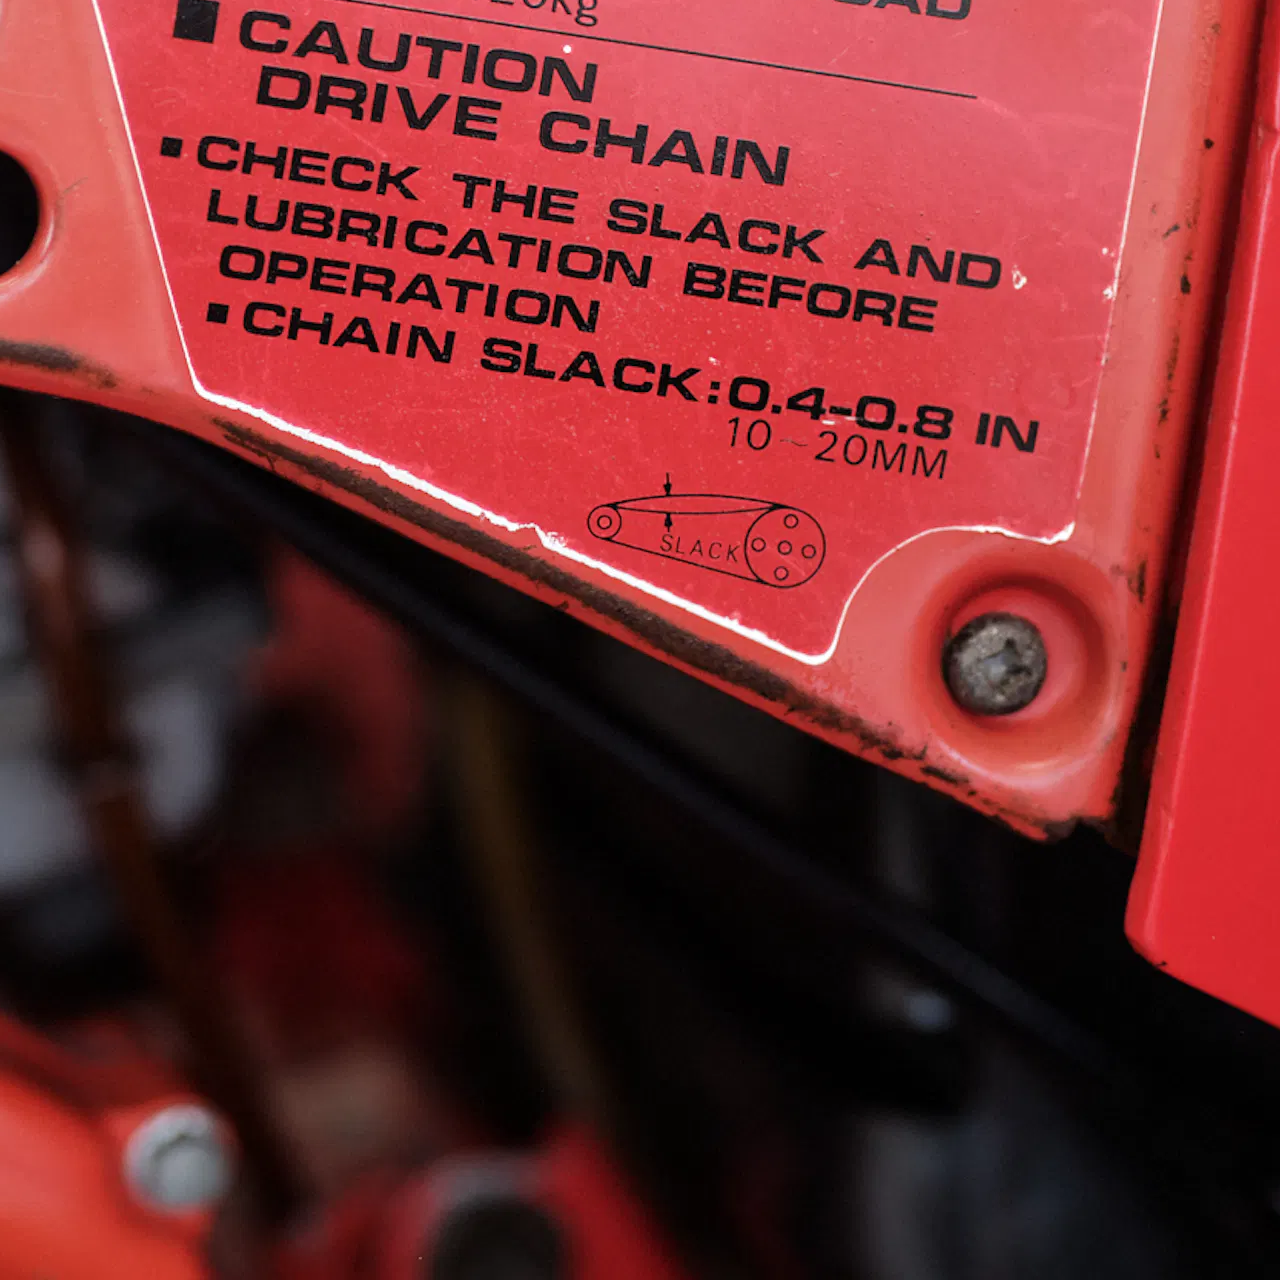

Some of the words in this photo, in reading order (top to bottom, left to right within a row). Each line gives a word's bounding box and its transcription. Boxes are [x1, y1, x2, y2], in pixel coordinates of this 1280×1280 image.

[239, 10, 598, 103] CAUTION
[256, 65, 502, 141] DRIVE
[539, 111, 790, 186] CHAIN
[197, 135, 421, 201] CHECK
[452, 173, 579, 224] THE
[606, 198, 826, 264] SLACK
[854, 238, 1002, 289] AND
[207, 188, 652, 288] LUBRICATION
[683, 262, 938, 333] BEFORE
[219, 245, 600, 334] OPERATION
[243, 301, 456, 364] CHAIN
[975, 412, 1040, 453] IN
[660, 534, 739, 563] SLACK
